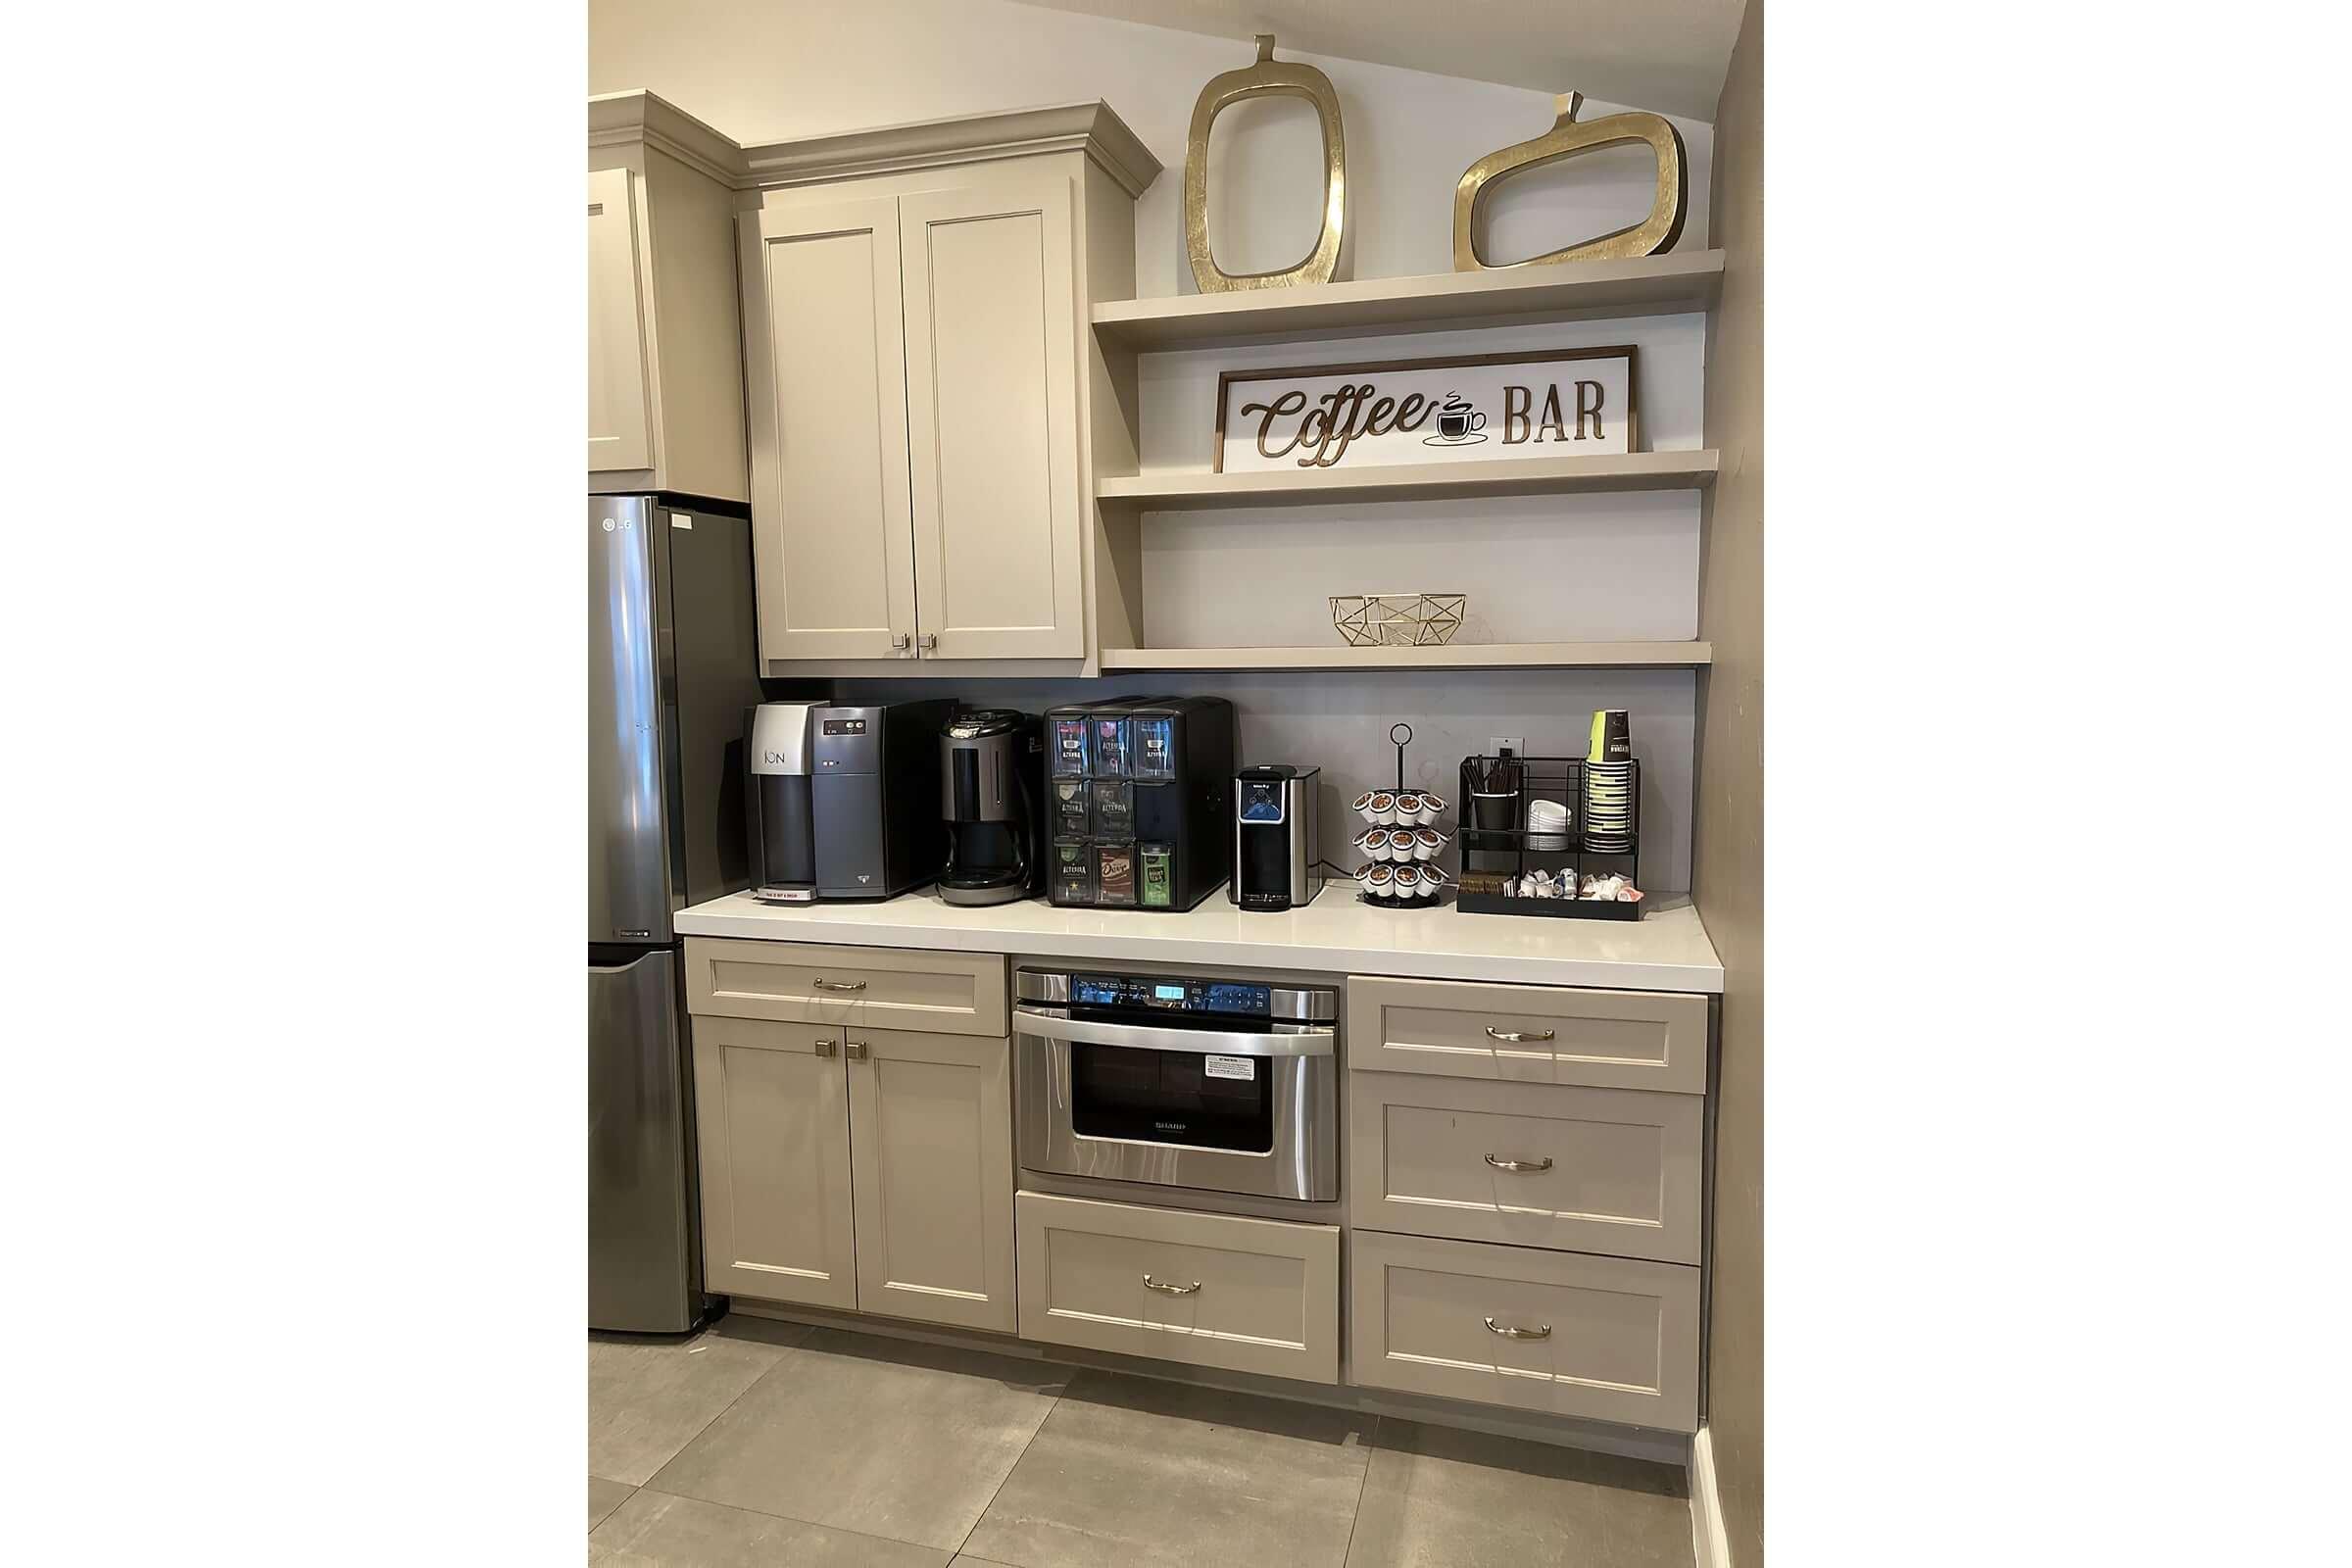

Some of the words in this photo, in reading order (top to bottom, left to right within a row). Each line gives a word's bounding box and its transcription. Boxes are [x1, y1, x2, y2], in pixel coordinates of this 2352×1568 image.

[1241, 383, 1439, 467] Coffee
[1501, 380, 1606, 445] BAR
[764, 750, 785, 764] ION
